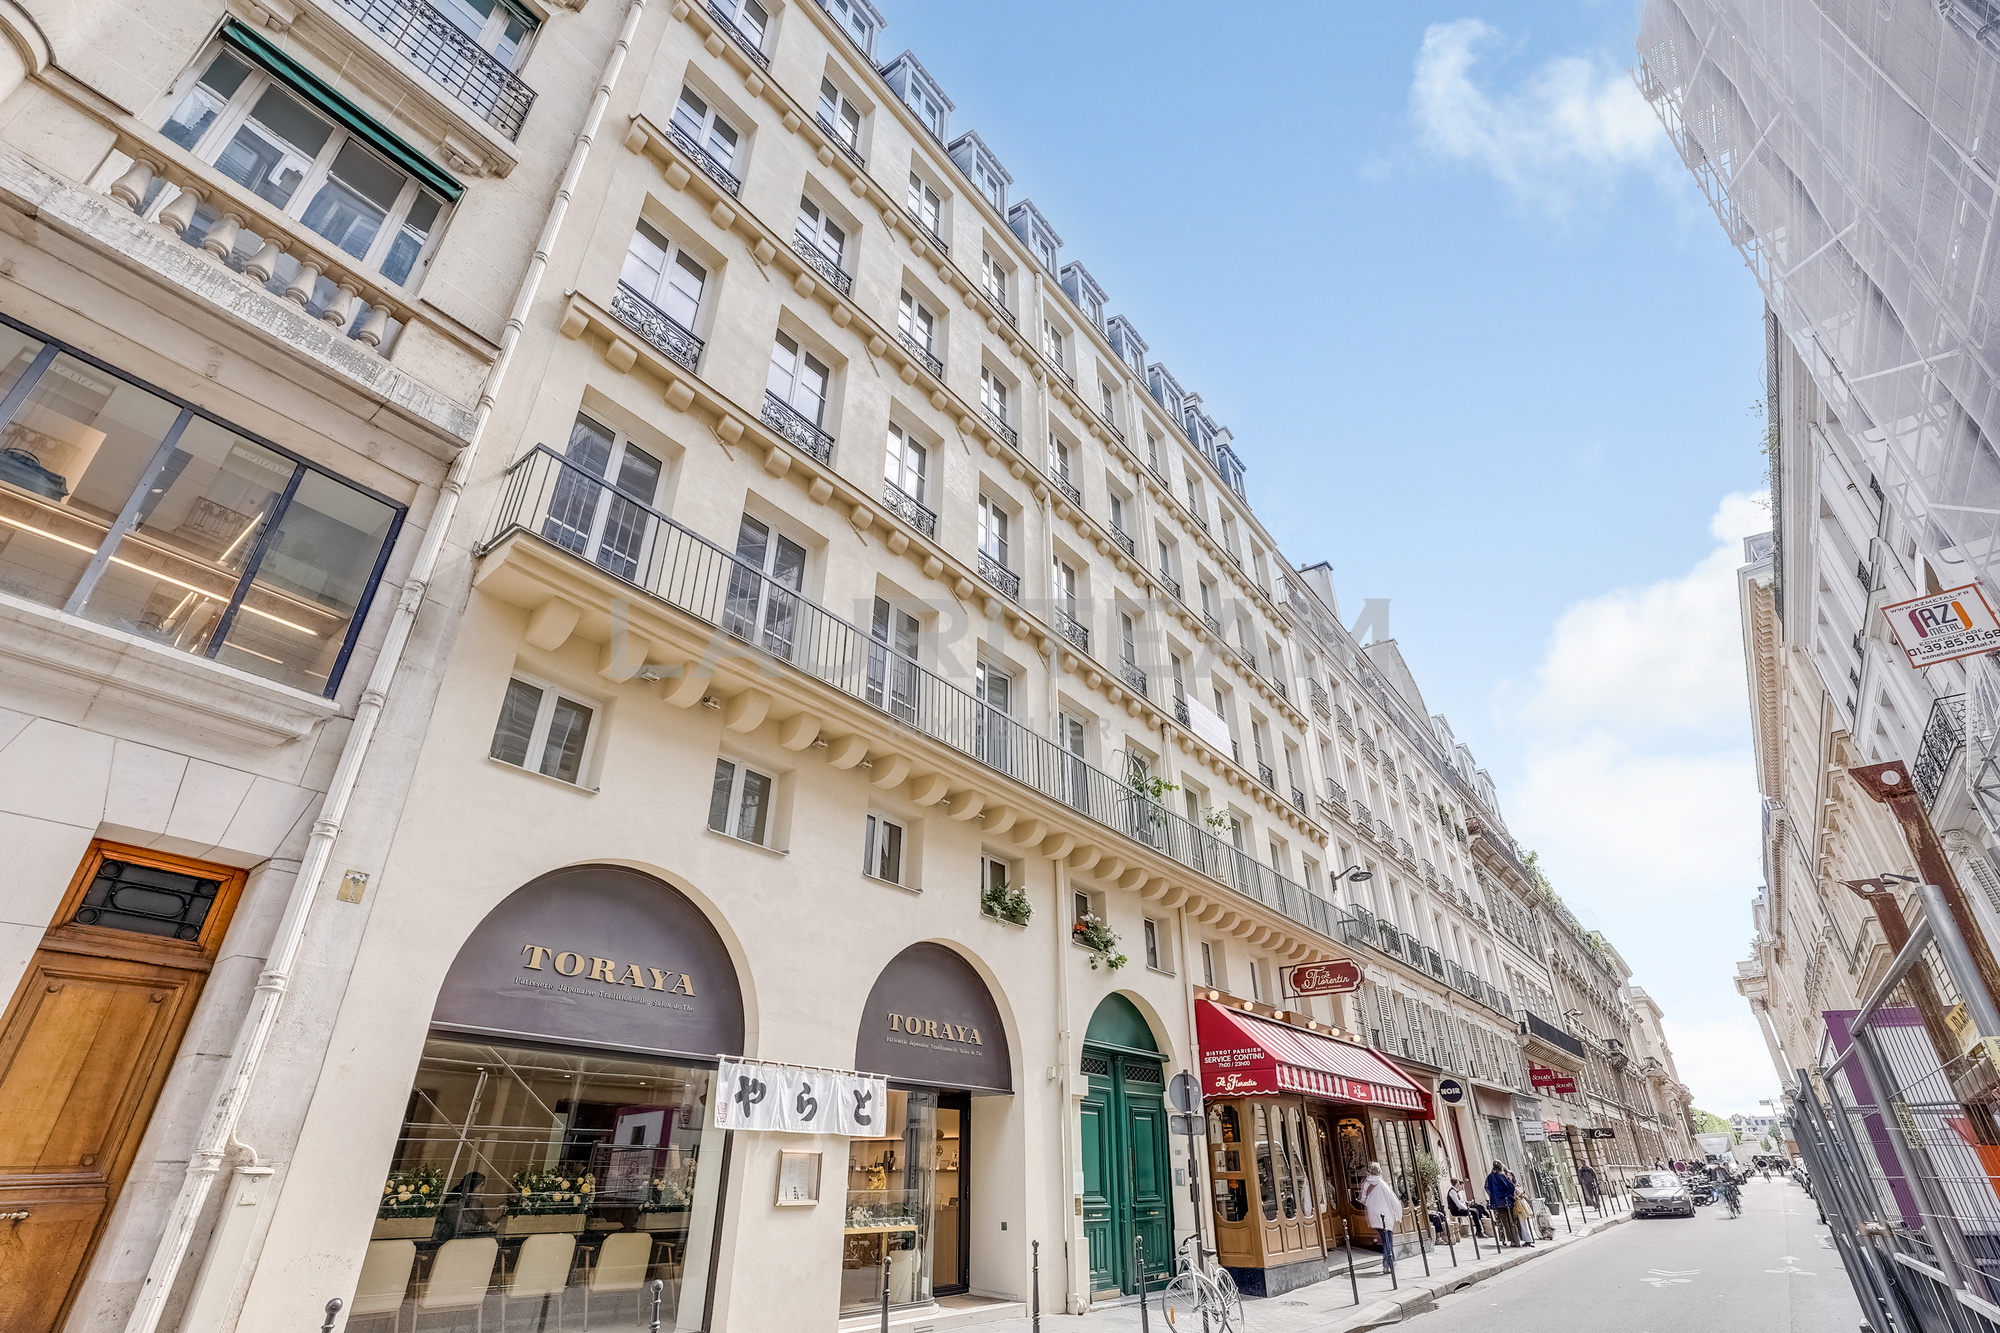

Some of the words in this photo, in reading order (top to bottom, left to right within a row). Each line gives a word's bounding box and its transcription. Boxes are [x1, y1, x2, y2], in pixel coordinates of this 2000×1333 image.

[1889, 590, 1970, 614] WWW.AZMETAL.FR
[1918, 603, 1958, 629] AZ
[1929, 622, 1963, 637] METAL
[1921, 640, 1998, 661] azmetal@azmetal.fr
[521, 944, 697, 998] TORAYA
[1301, 966, 1350, 989] Florentin
[673, 1002, 682, 1010] de
[887, 1012, 983, 1046] TORAYA
[1204, 1055, 1232, 1064] SERVICE
[1233, 1052, 1265, 1061] CONTINU
[1206, 1049, 1232, 1057] BISTROT
[1233, 1047, 1262, 1055] PARISIEN
[1225, 1073, 1258, 1091] Florentin
[1440, 1087, 1461, 1096] NOIR
